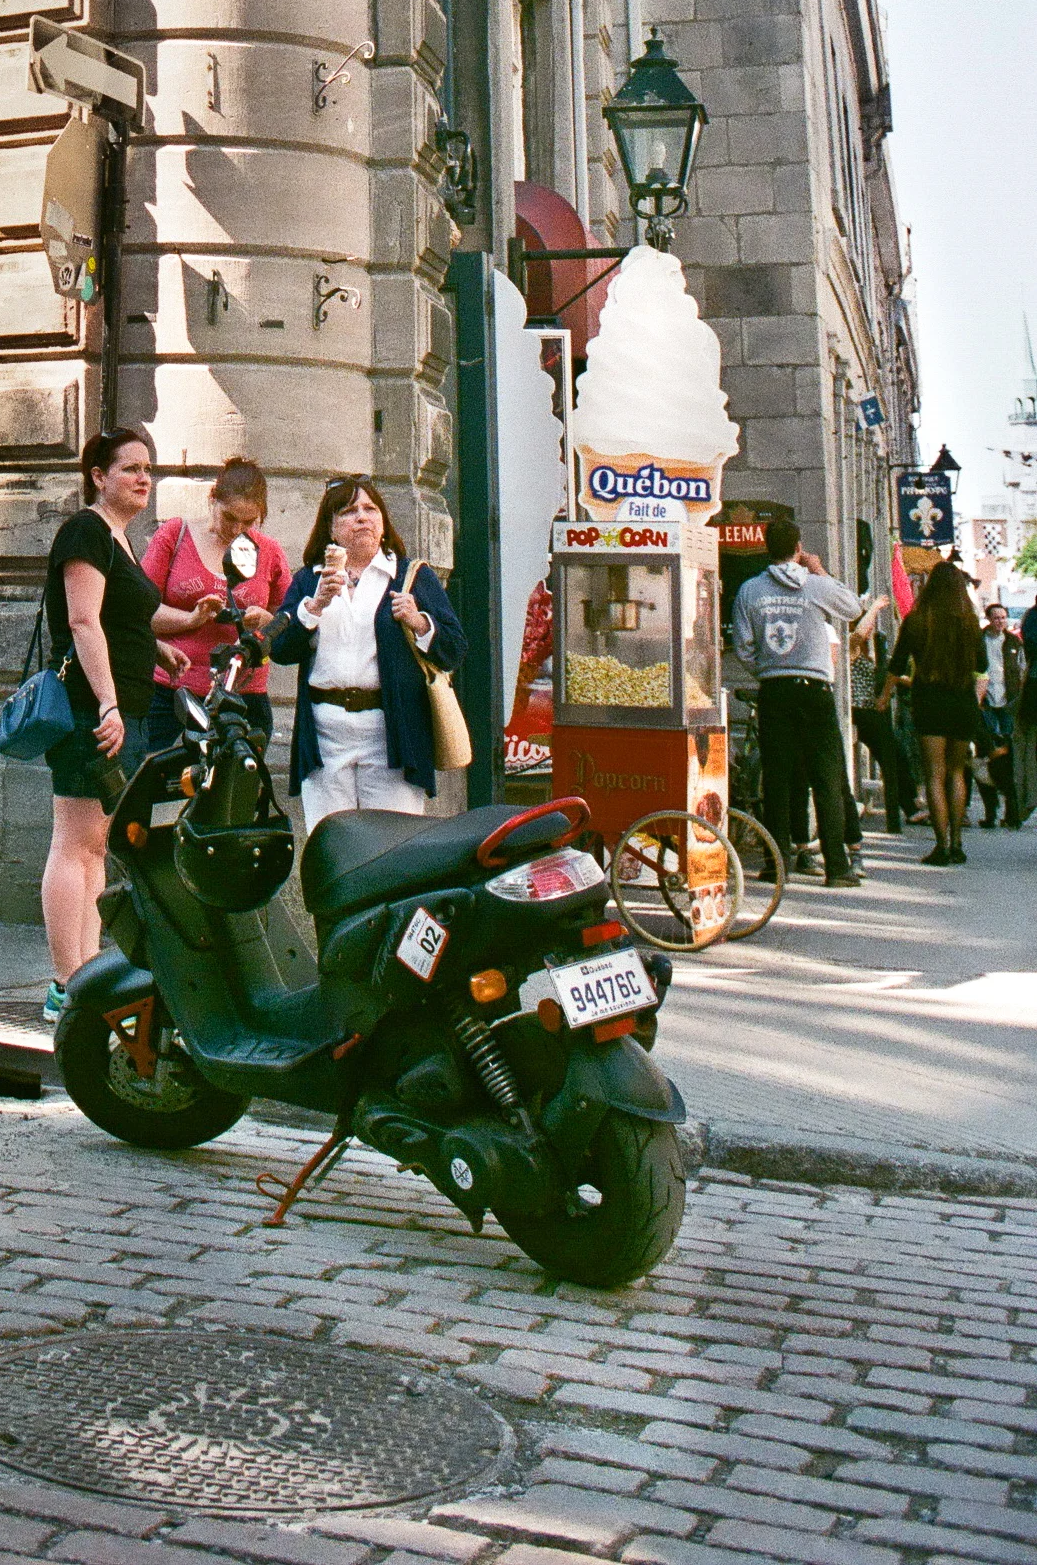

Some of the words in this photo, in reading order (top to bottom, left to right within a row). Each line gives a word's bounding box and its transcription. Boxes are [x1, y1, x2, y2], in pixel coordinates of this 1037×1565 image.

[591, 464, 708, 500] Québon
[629, 501, 650, 518] Fait
[652, 503, 667, 518] de
[566, 526, 600, 547] POP
[618, 526, 668, 548] CORN
[569, 749, 666, 793] Popcorn
[420, 925, 442, 954] 02
[570, 970, 642, 1013] 94476C
[599, 1008, 608, 1016] me
[609, 999, 636, 1012] souviens
